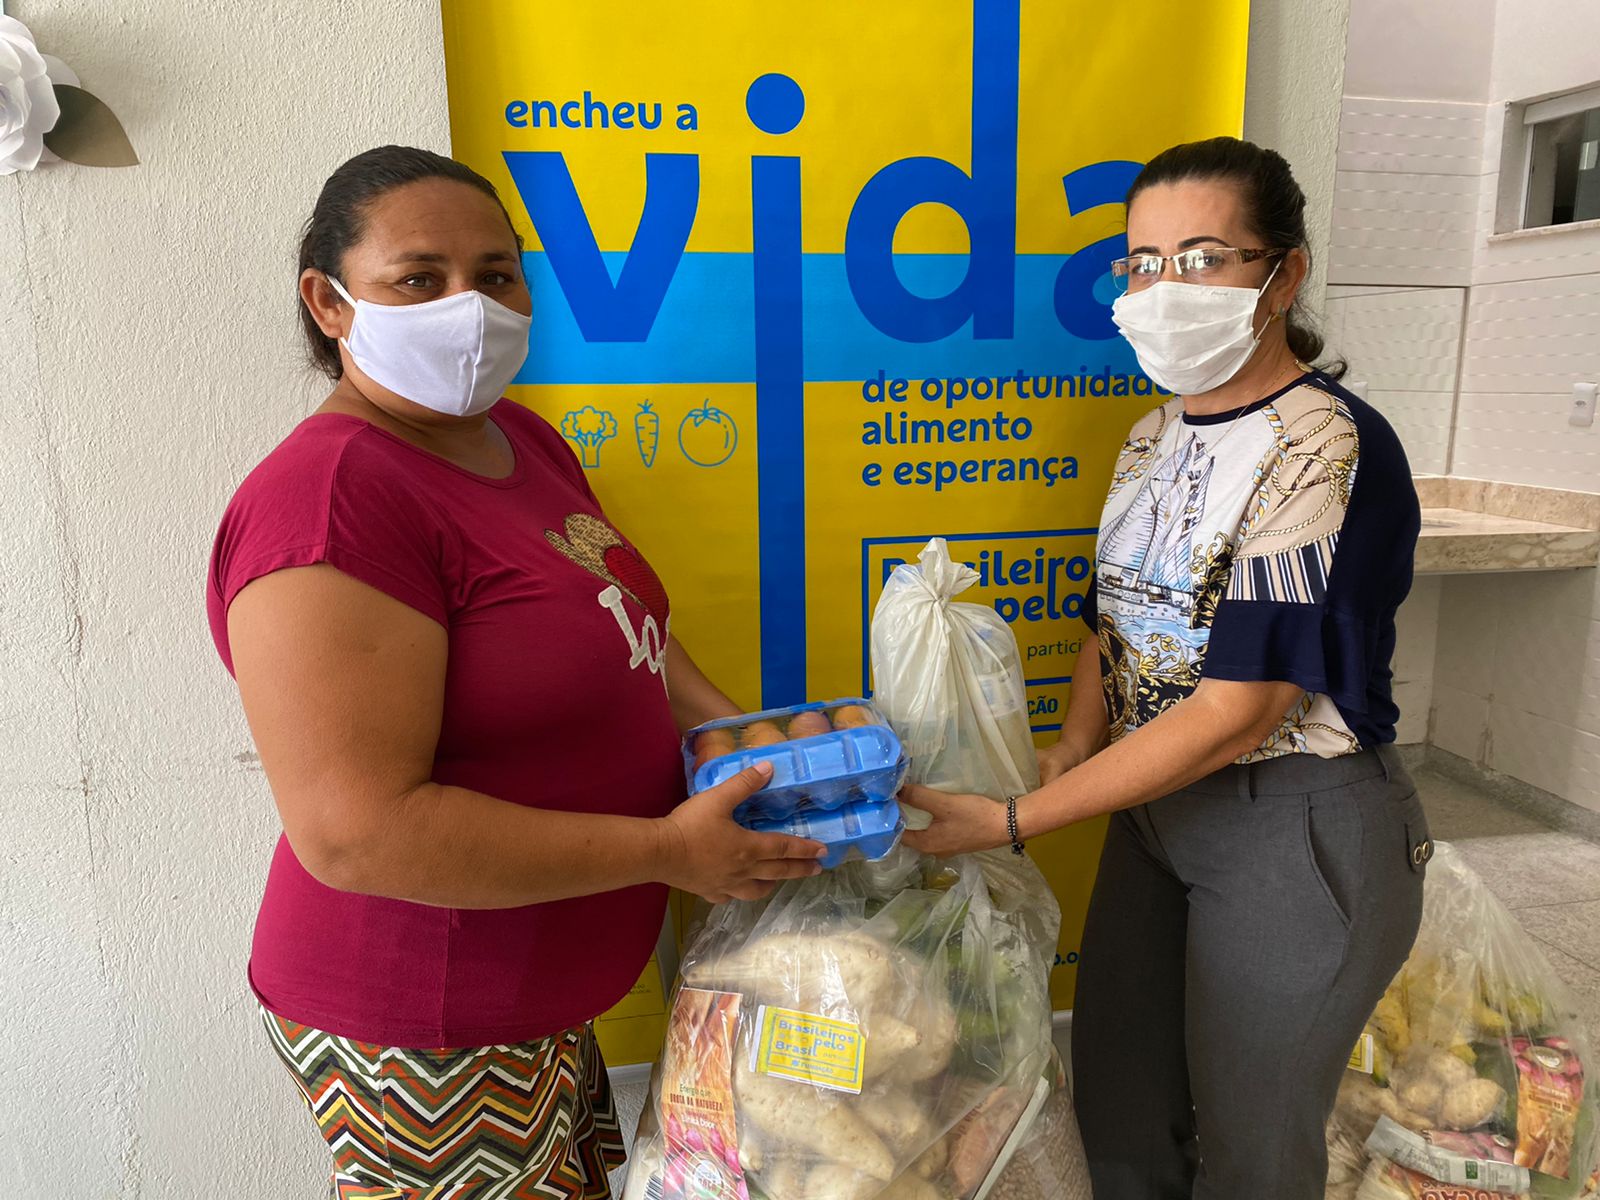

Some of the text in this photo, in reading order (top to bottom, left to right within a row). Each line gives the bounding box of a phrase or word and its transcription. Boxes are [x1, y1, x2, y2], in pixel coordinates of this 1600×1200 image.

[504, 91, 698, 131] encheu a
[861, 369, 909, 403] de
[861, 411, 1033, 445] alimento
[861, 455, 1079, 492] e esperança
[993, 584, 1084, 624] pelo
[775, 1040, 816, 1057] Brasil
[778, 1019, 855, 1044] Brasileiros
[813, 1035, 845, 1056] pelo
